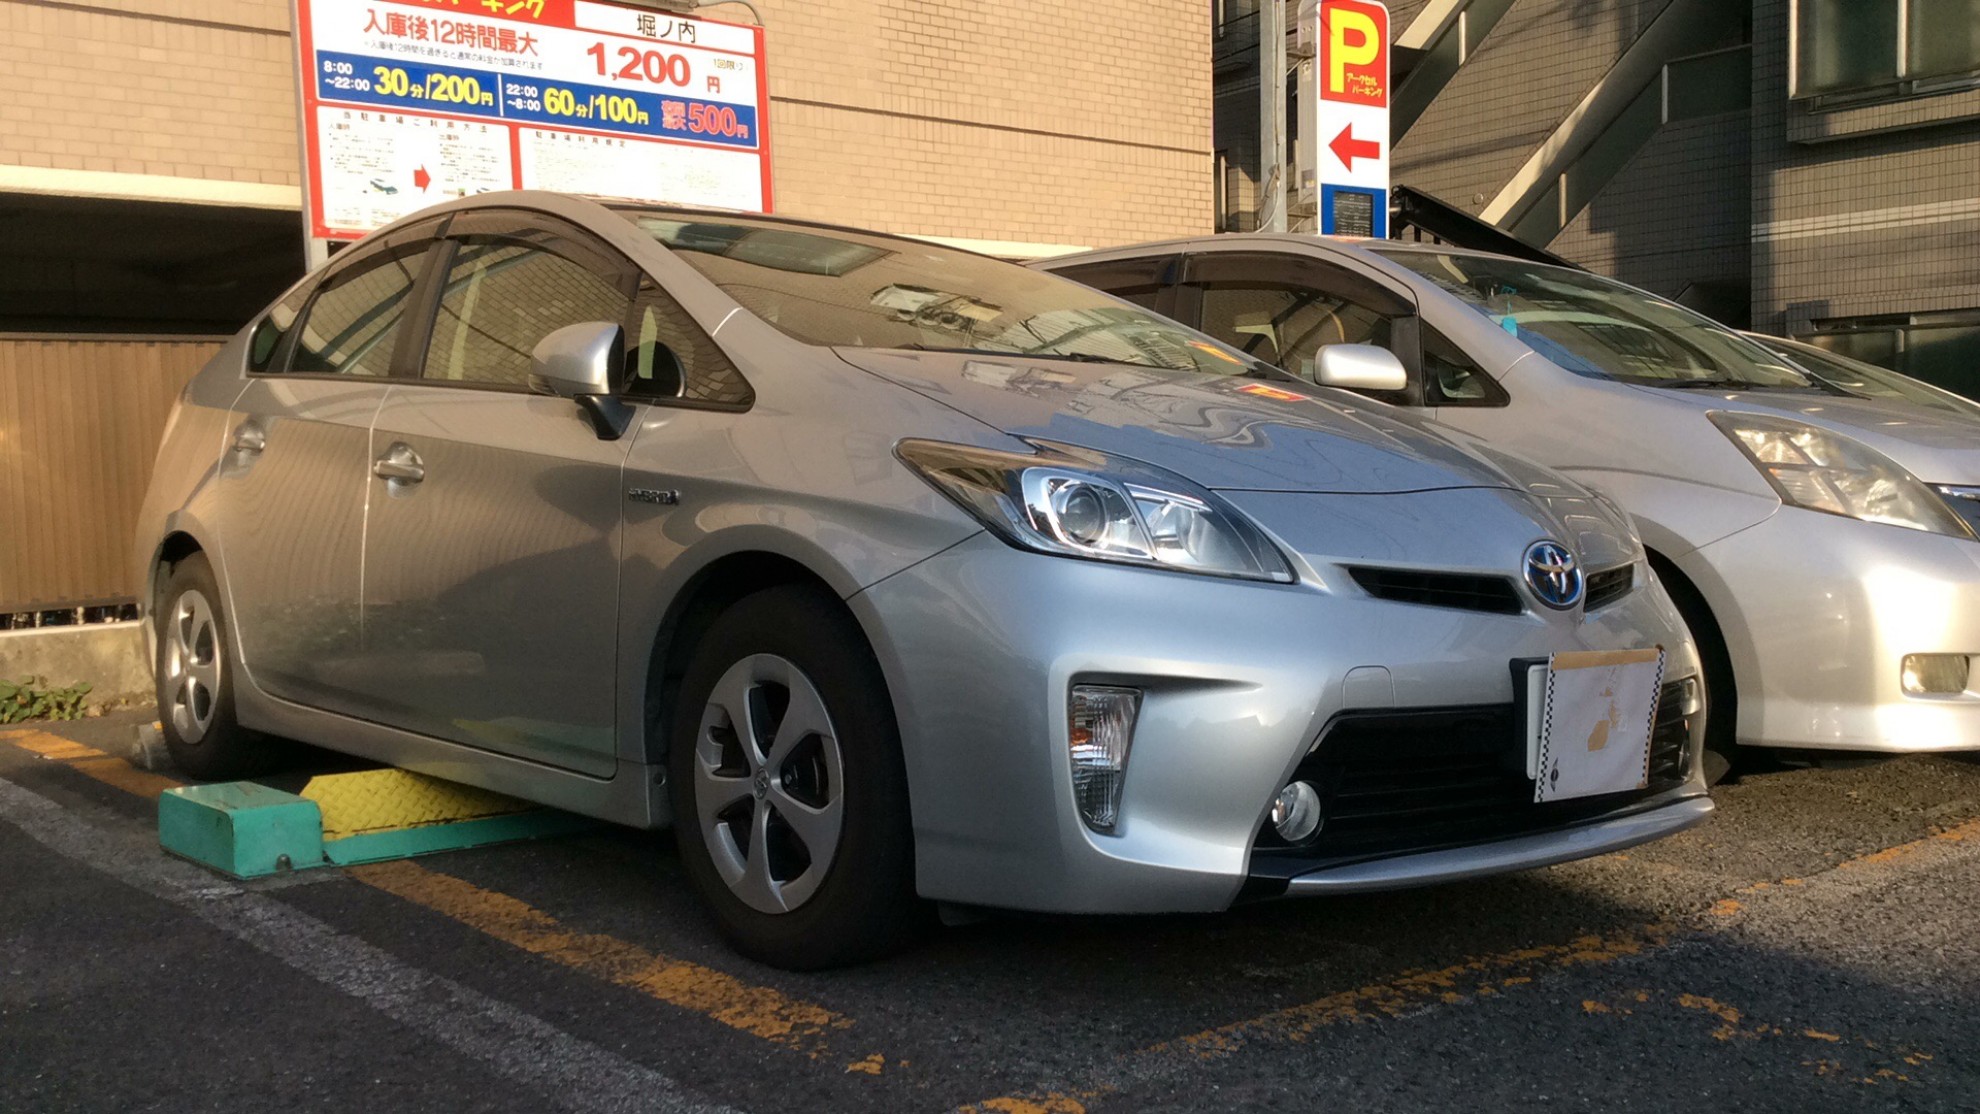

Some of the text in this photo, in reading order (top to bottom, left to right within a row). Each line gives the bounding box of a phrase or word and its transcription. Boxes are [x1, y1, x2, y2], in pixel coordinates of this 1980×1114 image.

[363, 8, 540, 57] 入庫後12時間最大
[636, 14, 697, 44] 堀ノ内
[1329, 7, 1380, 94] P
[323, 60, 353, 75] 8:00
[505, 83, 539, 98] 22:00
